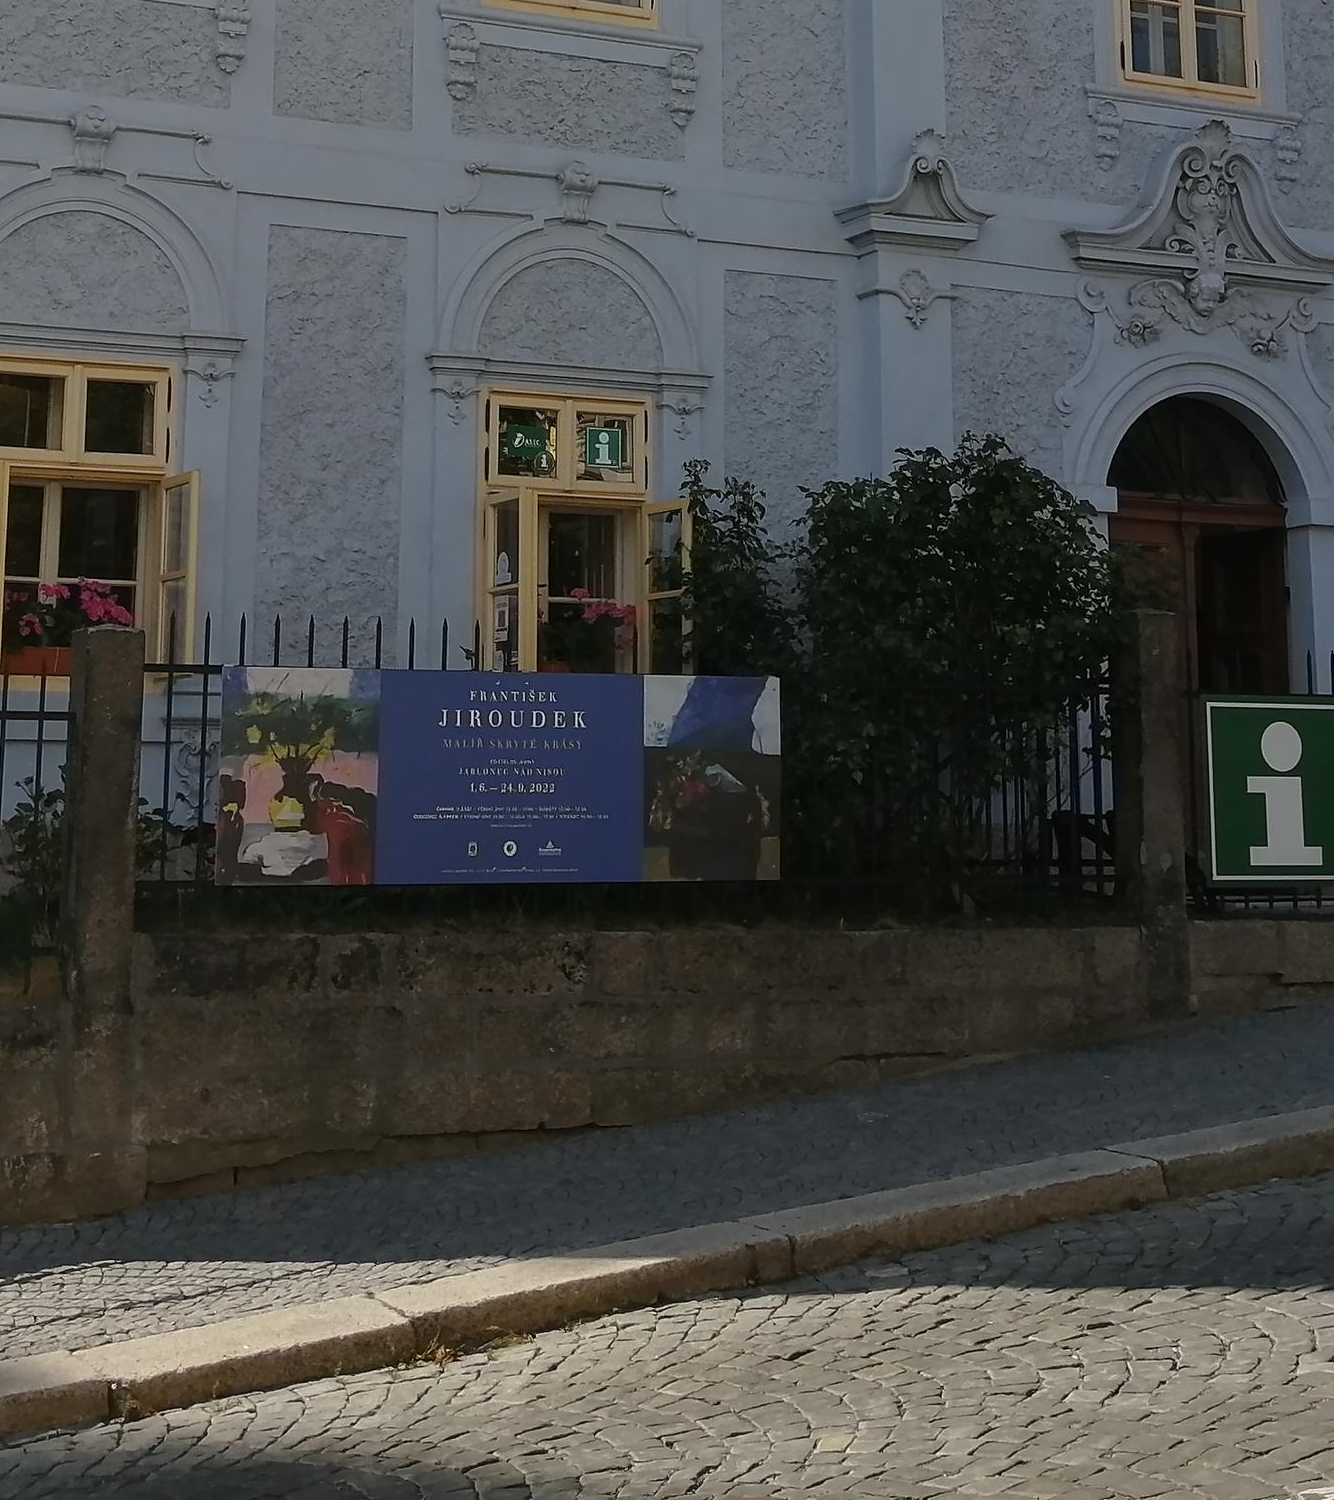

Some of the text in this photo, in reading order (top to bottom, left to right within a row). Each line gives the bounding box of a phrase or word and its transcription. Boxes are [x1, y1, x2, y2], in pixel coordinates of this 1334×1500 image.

[469, 687, 557, 703] FRANTIŠEK
[438, 709, 587, 728] JIROUDEK
[442, 736, 583, 750] MALÍŘ SKRYTÉ KRÁSY
[458, 767, 566, 777] JABLONEC NAD NISOU
[529, 782, 555, 794] 2022
